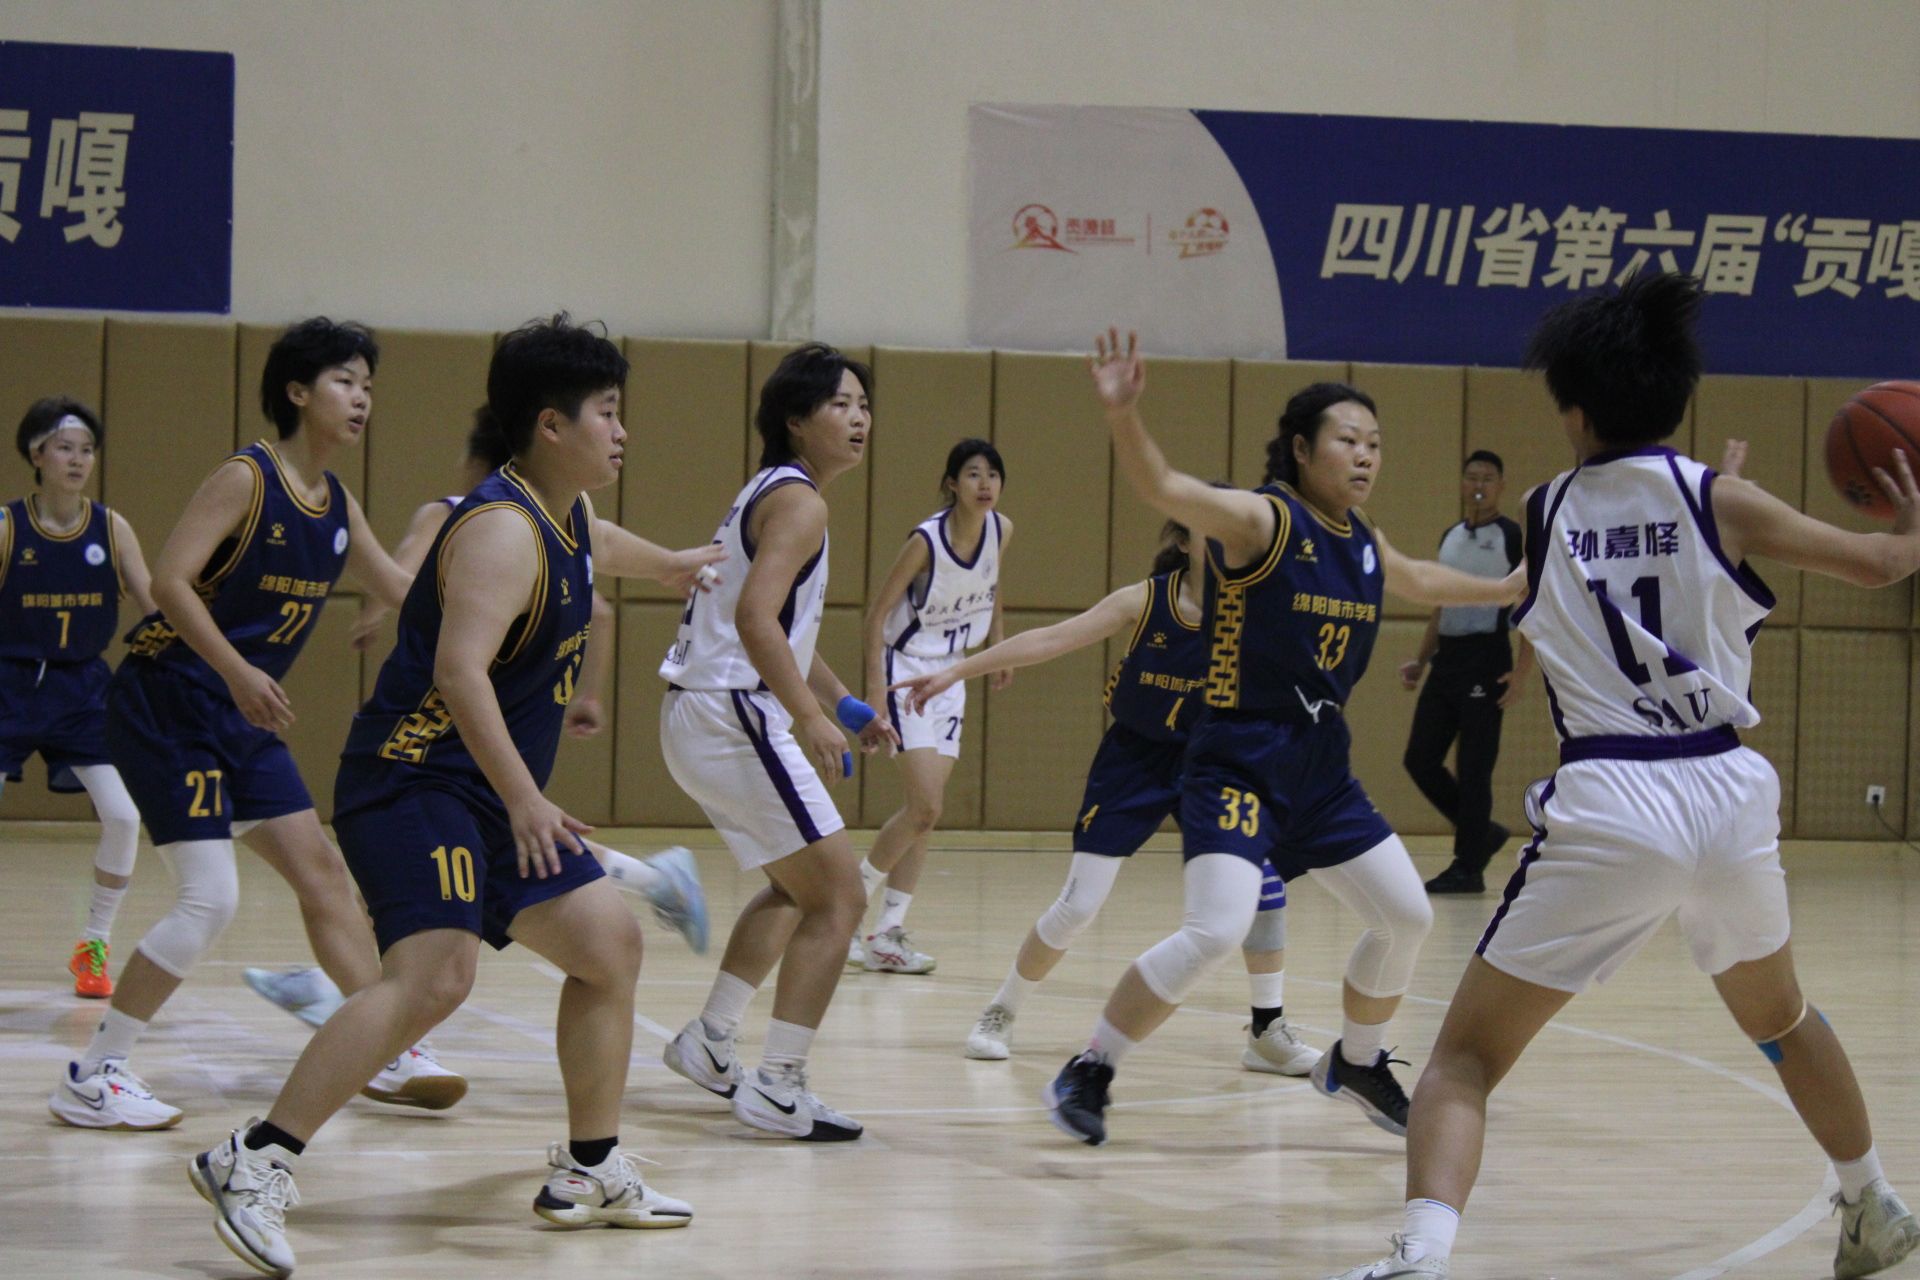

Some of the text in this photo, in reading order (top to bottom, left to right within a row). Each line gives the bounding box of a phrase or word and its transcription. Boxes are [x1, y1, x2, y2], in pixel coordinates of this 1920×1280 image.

[1567, 521, 1680, 562] 孙嘉怿
[56, 611, 71, 649] 7
[266, 600, 313, 645] 27
[944, 622, 971, 653] 77
[1586, 576, 1699, 686] 11
[1314, 622, 1351, 671] 33
[946, 715, 964, 742] 7
[185, 770, 223, 818] 27
[1218, 787, 1260, 838] 33
[429, 845, 477, 903] 10
